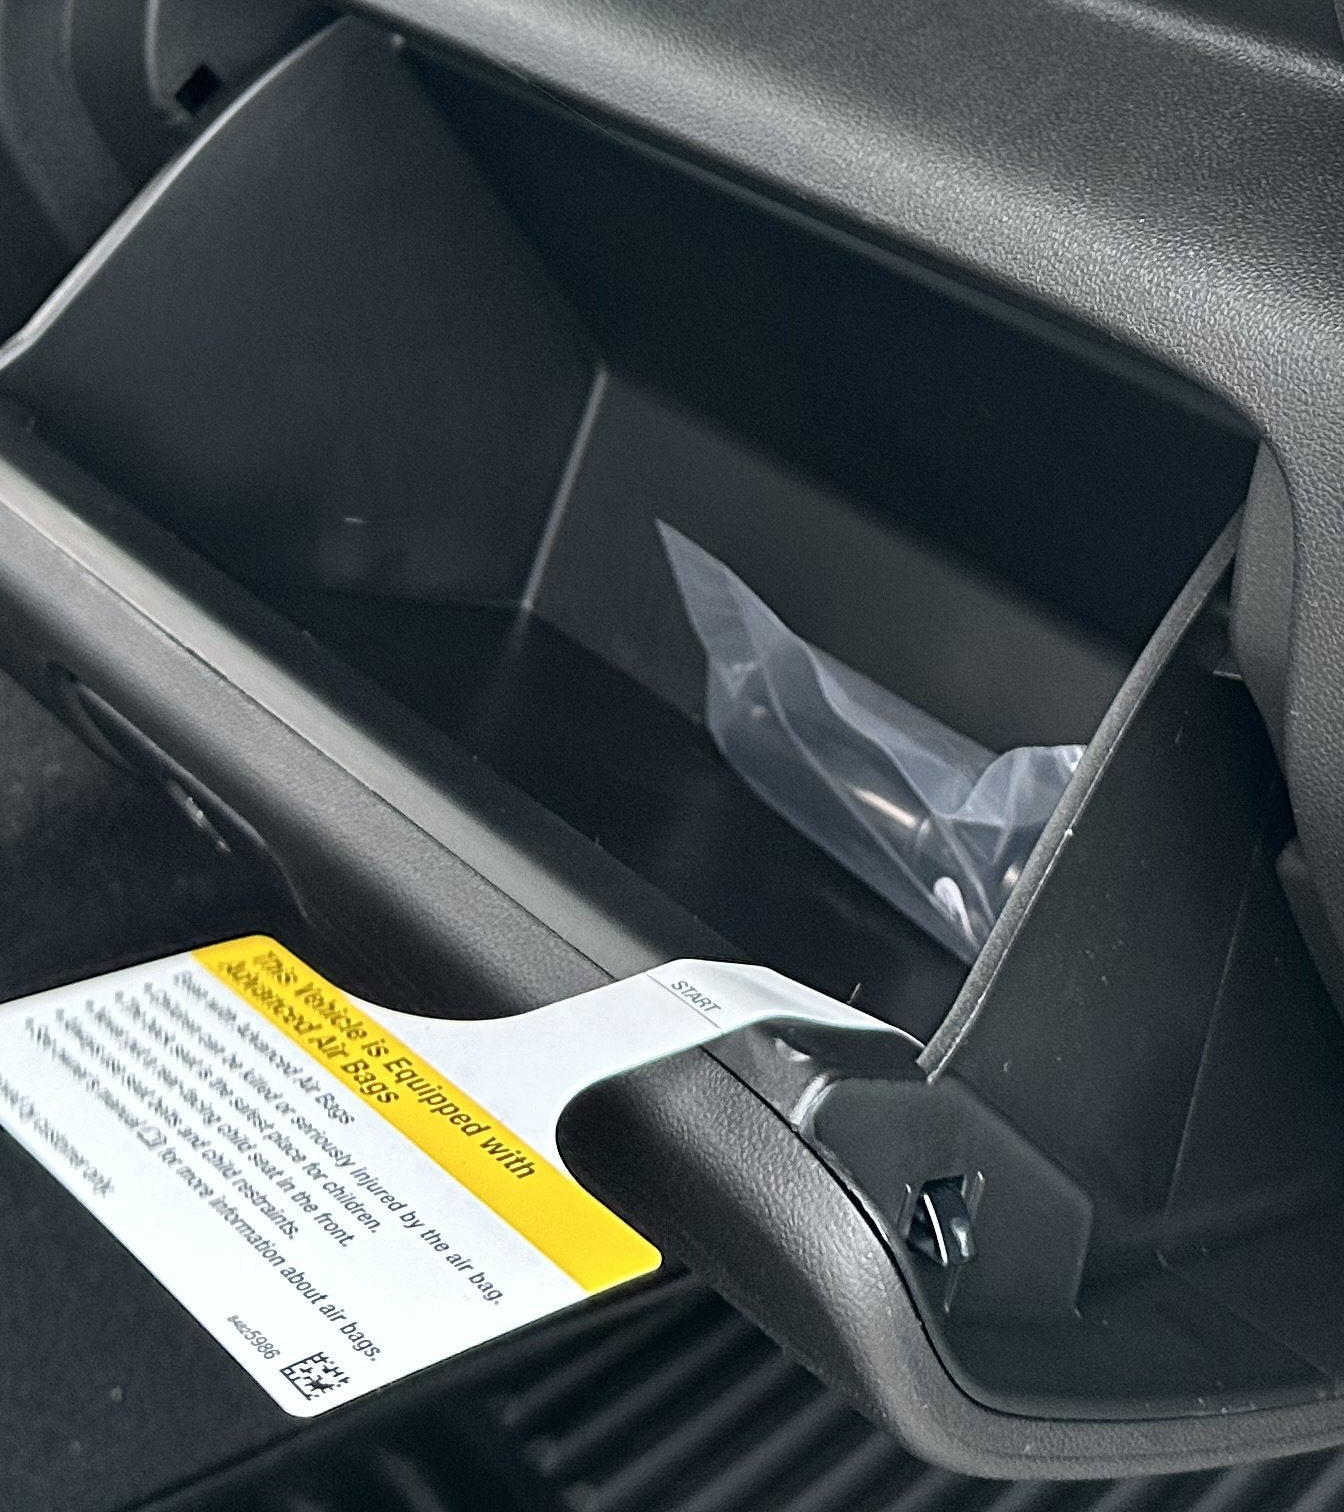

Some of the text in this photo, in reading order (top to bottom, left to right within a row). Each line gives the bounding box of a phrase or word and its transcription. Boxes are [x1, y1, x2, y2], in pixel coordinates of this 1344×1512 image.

[671, 980, 721, 1012] START
[293, 1076, 320, 1094] Air
[315, 1093, 355, 1124] Bags
[295, 982, 367, 1040] Vehicle
[361, 1039, 389, 1058] is
[383, 1057, 491, 1136] Equipped
[480, 1137, 535, 1179] with
[308, 1036, 349, 1059] Air
[341, 1059, 399, 1103] Bags
[177, 1128, 211, 1151] and
[202, 1150, 242, 1179] child
[232, 1179, 298, 1240] restraints.
[205, 1077, 233, 1098] the
[229, 1097, 274, 1133] safest
[263, 1131, 306, 1163] place
[302, 1163, 328, 1180] for
[323, 1182, 380, 1233] children.
[217, 1124, 257, 1153] child
[248, 1153, 284, 1180] seat
[276, 1176, 295, 1193] in
[291, 1191, 318, 1213] the
[314, 1213, 355, 1247] front.
[241, 1068, 283, 1102] killed
[275, 1102, 296, 1115] or
[291, 1116, 356, 1167] seriously
[350, 1167, 408, 1211] injured
[400, 1211, 425, 1228] by
[420, 1229, 449, 1252] the
[446, 1254, 474, 1271] air
[468, 1272, 503, 1304] bag.
[158, 1147, 183, 1167] for
[176, 1166, 214, 1198] more
[209, 1195, 285, 1266] information
[280, 1267, 328, 1304] about
[319, 1305, 347, 1321] air
[339, 1322, 380, 1361] bags.
